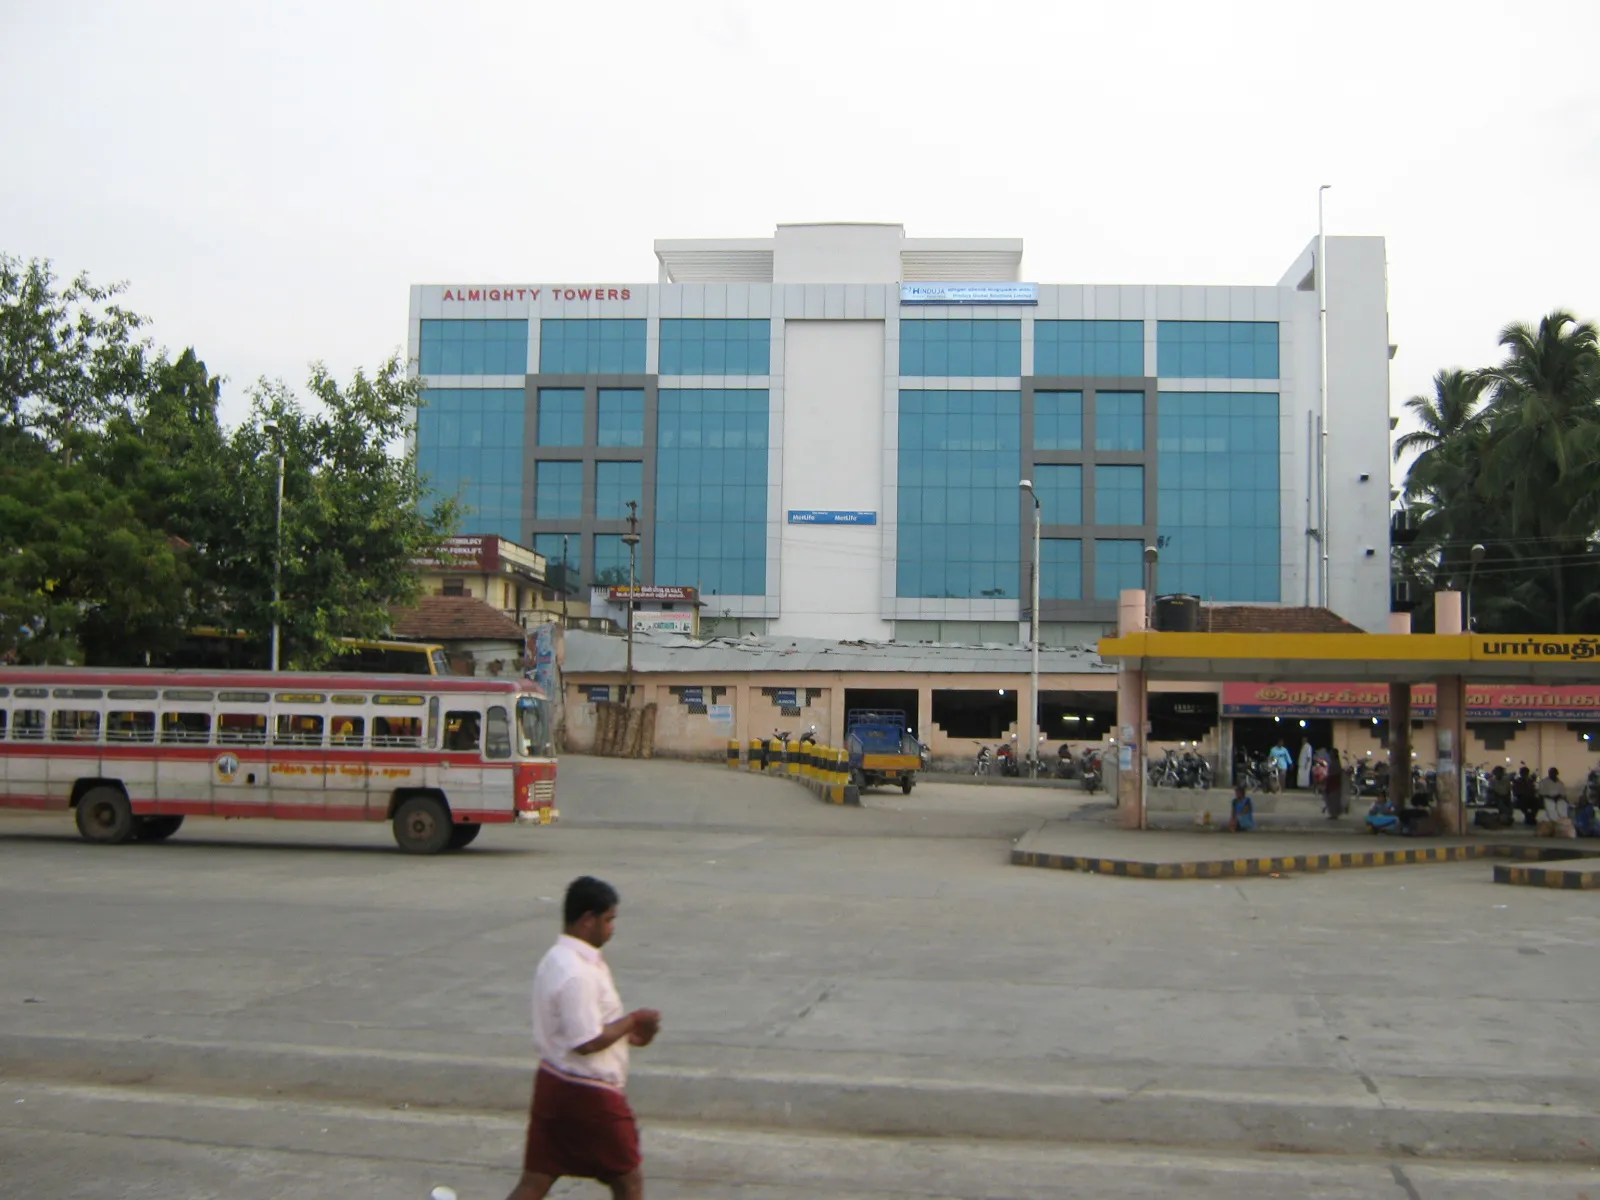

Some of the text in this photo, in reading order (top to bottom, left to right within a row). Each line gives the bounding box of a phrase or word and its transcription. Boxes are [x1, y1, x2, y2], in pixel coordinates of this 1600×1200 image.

[443, 288, 632, 301] ALMIGHTY TOWERS
[834, 514, 857, 522] MetLife
[1483, 637, 1600, 661] பார்வதி
[1499, 690, 1600, 706] காப்பக
